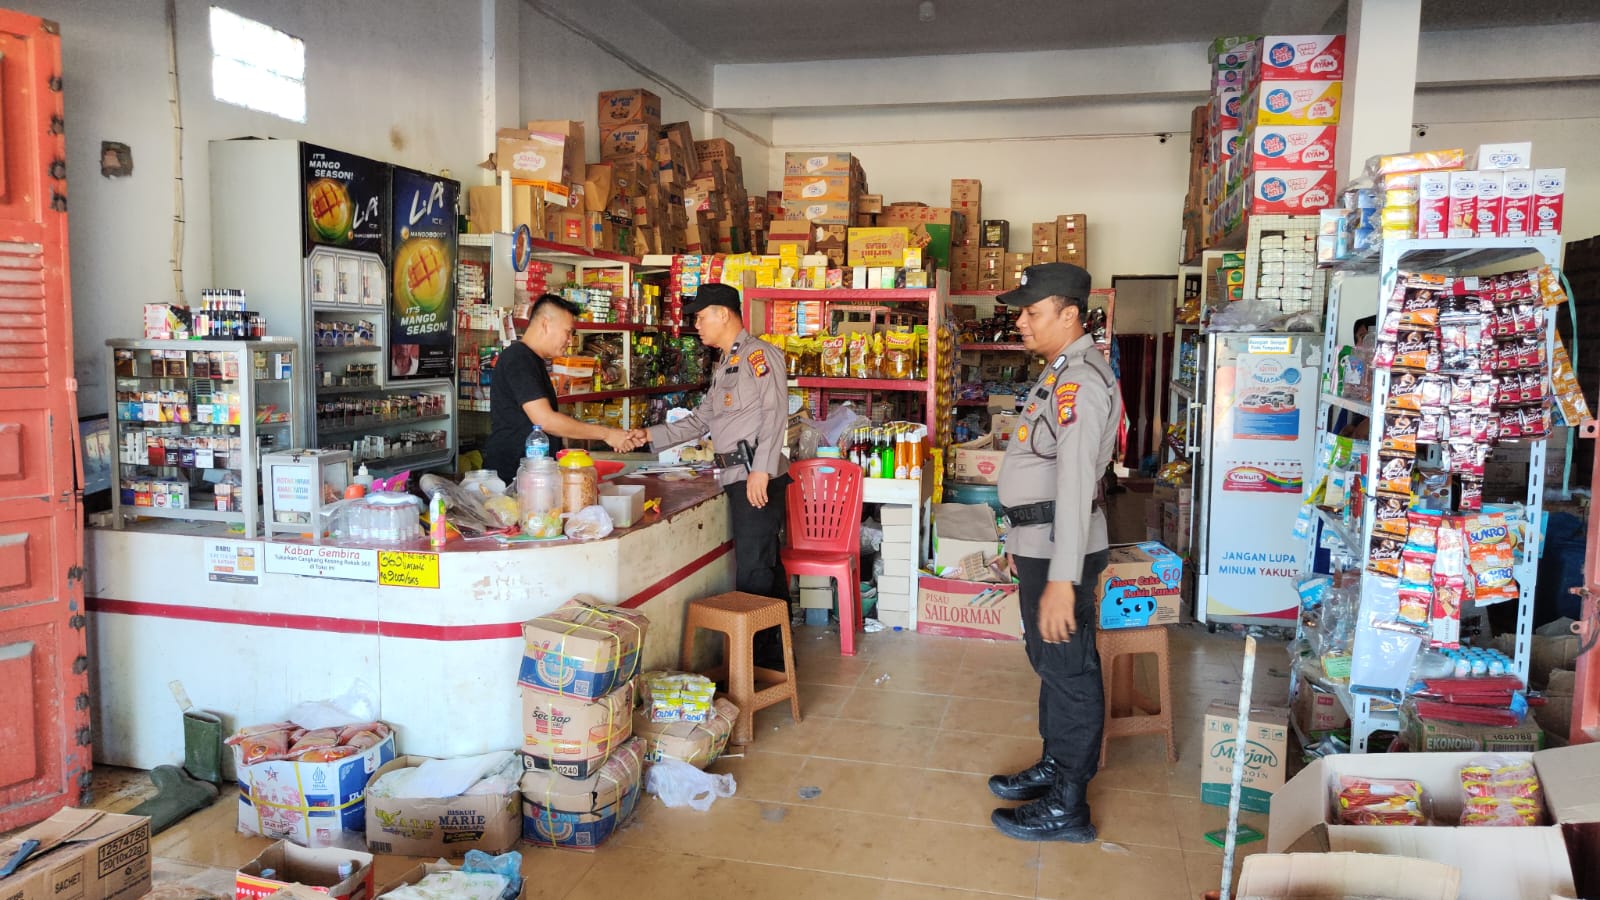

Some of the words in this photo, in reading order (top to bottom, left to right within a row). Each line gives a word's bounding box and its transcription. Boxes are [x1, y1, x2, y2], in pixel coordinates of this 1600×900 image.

[309, 160, 341, 169] MANGO
[315, 169, 354, 180] SEASON!
[406, 306, 420, 314] IT'S
[400, 312, 437, 326] MANGO
[406, 321, 448, 336] SEASON!
[1470, 526, 1506, 543] SUKRO
[284, 545, 314, 556] Kabar
[318, 548, 360, 560] Gembira
[1222, 551, 1266, 562] JANGAN
[1269, 554, 1296, 563] LUPA
[1163, 568, 1180, 581] 60
[1218, 565, 1256, 575] MINUM
[1259, 567, 1299, 577] YAKULT
[1111, 579, 1136, 588] Snow
[1137, 576, 1161, 585] Cake
[1151, 587, 1180, 596] Lunak
[926, 593, 949, 604] PISAU
[925, 603, 1001, 625] SAILORMAN
[1426, 737, 1474, 750] EKONOMI
[526, 760, 533, 768] 9
[554, 765, 578, 775] 0240
[439, 815, 486, 825] MARIE
[55, 872, 81, 894] SACHET
